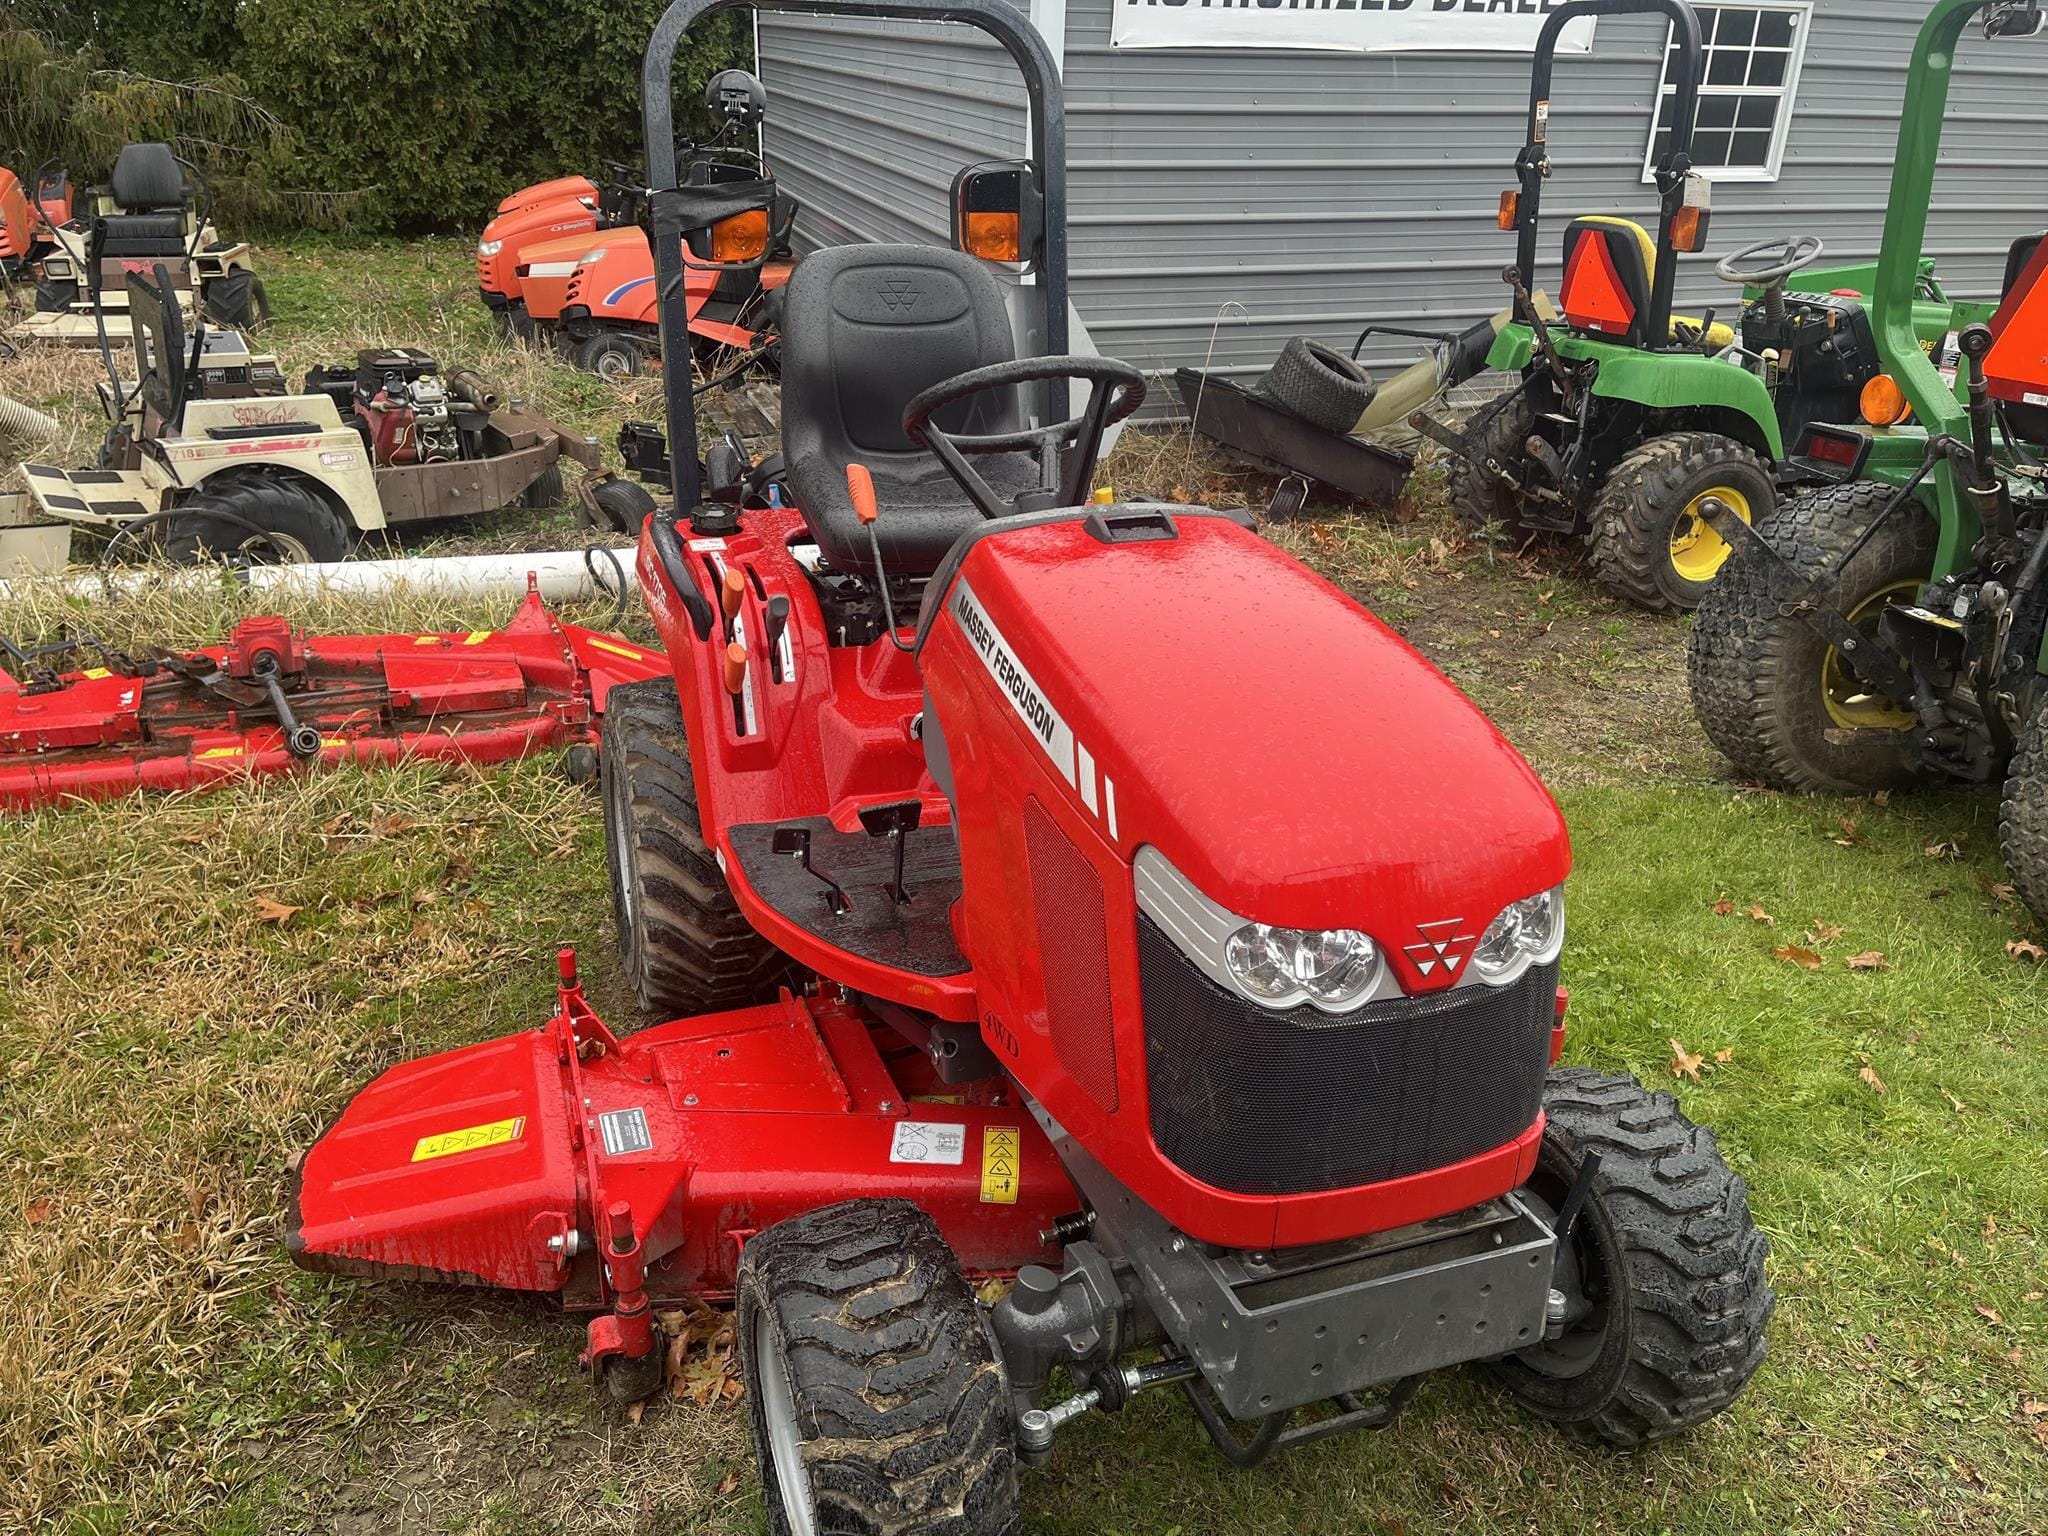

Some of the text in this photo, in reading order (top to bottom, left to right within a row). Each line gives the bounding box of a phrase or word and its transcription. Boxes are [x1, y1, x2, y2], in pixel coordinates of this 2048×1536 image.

[957, 595, 1056, 745] MASSEY FERGUSON
[984, 1010, 1019, 1058] 4WD
